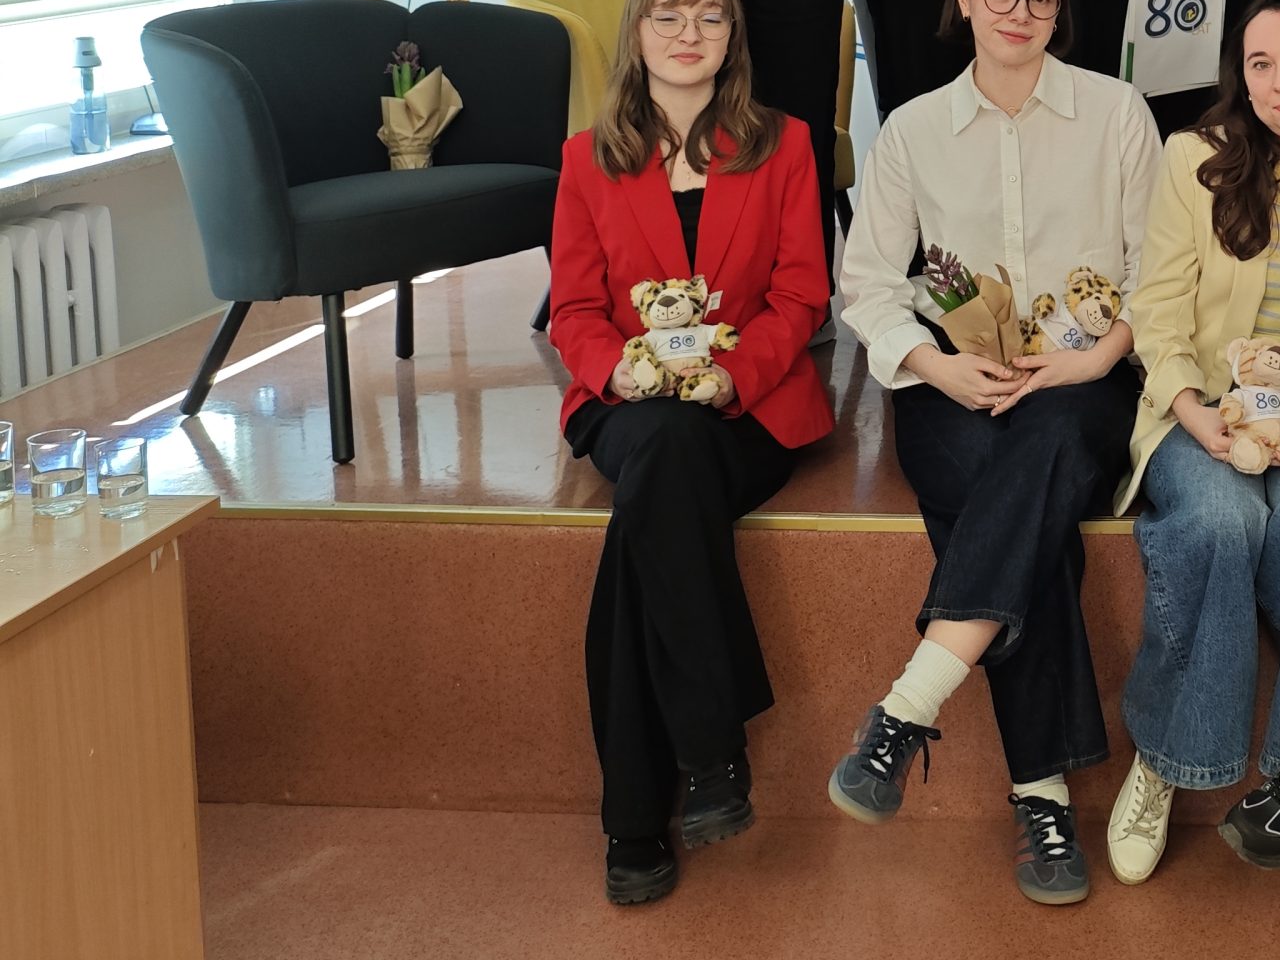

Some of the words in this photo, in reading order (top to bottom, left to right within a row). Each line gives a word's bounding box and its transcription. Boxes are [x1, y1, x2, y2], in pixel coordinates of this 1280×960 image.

[1191, 22, 1212, 36] LAT
[670, 335, 695, 349] 80
[1064, 328, 1082, 349] 80
[1256, 392, 1280, 409] 80
